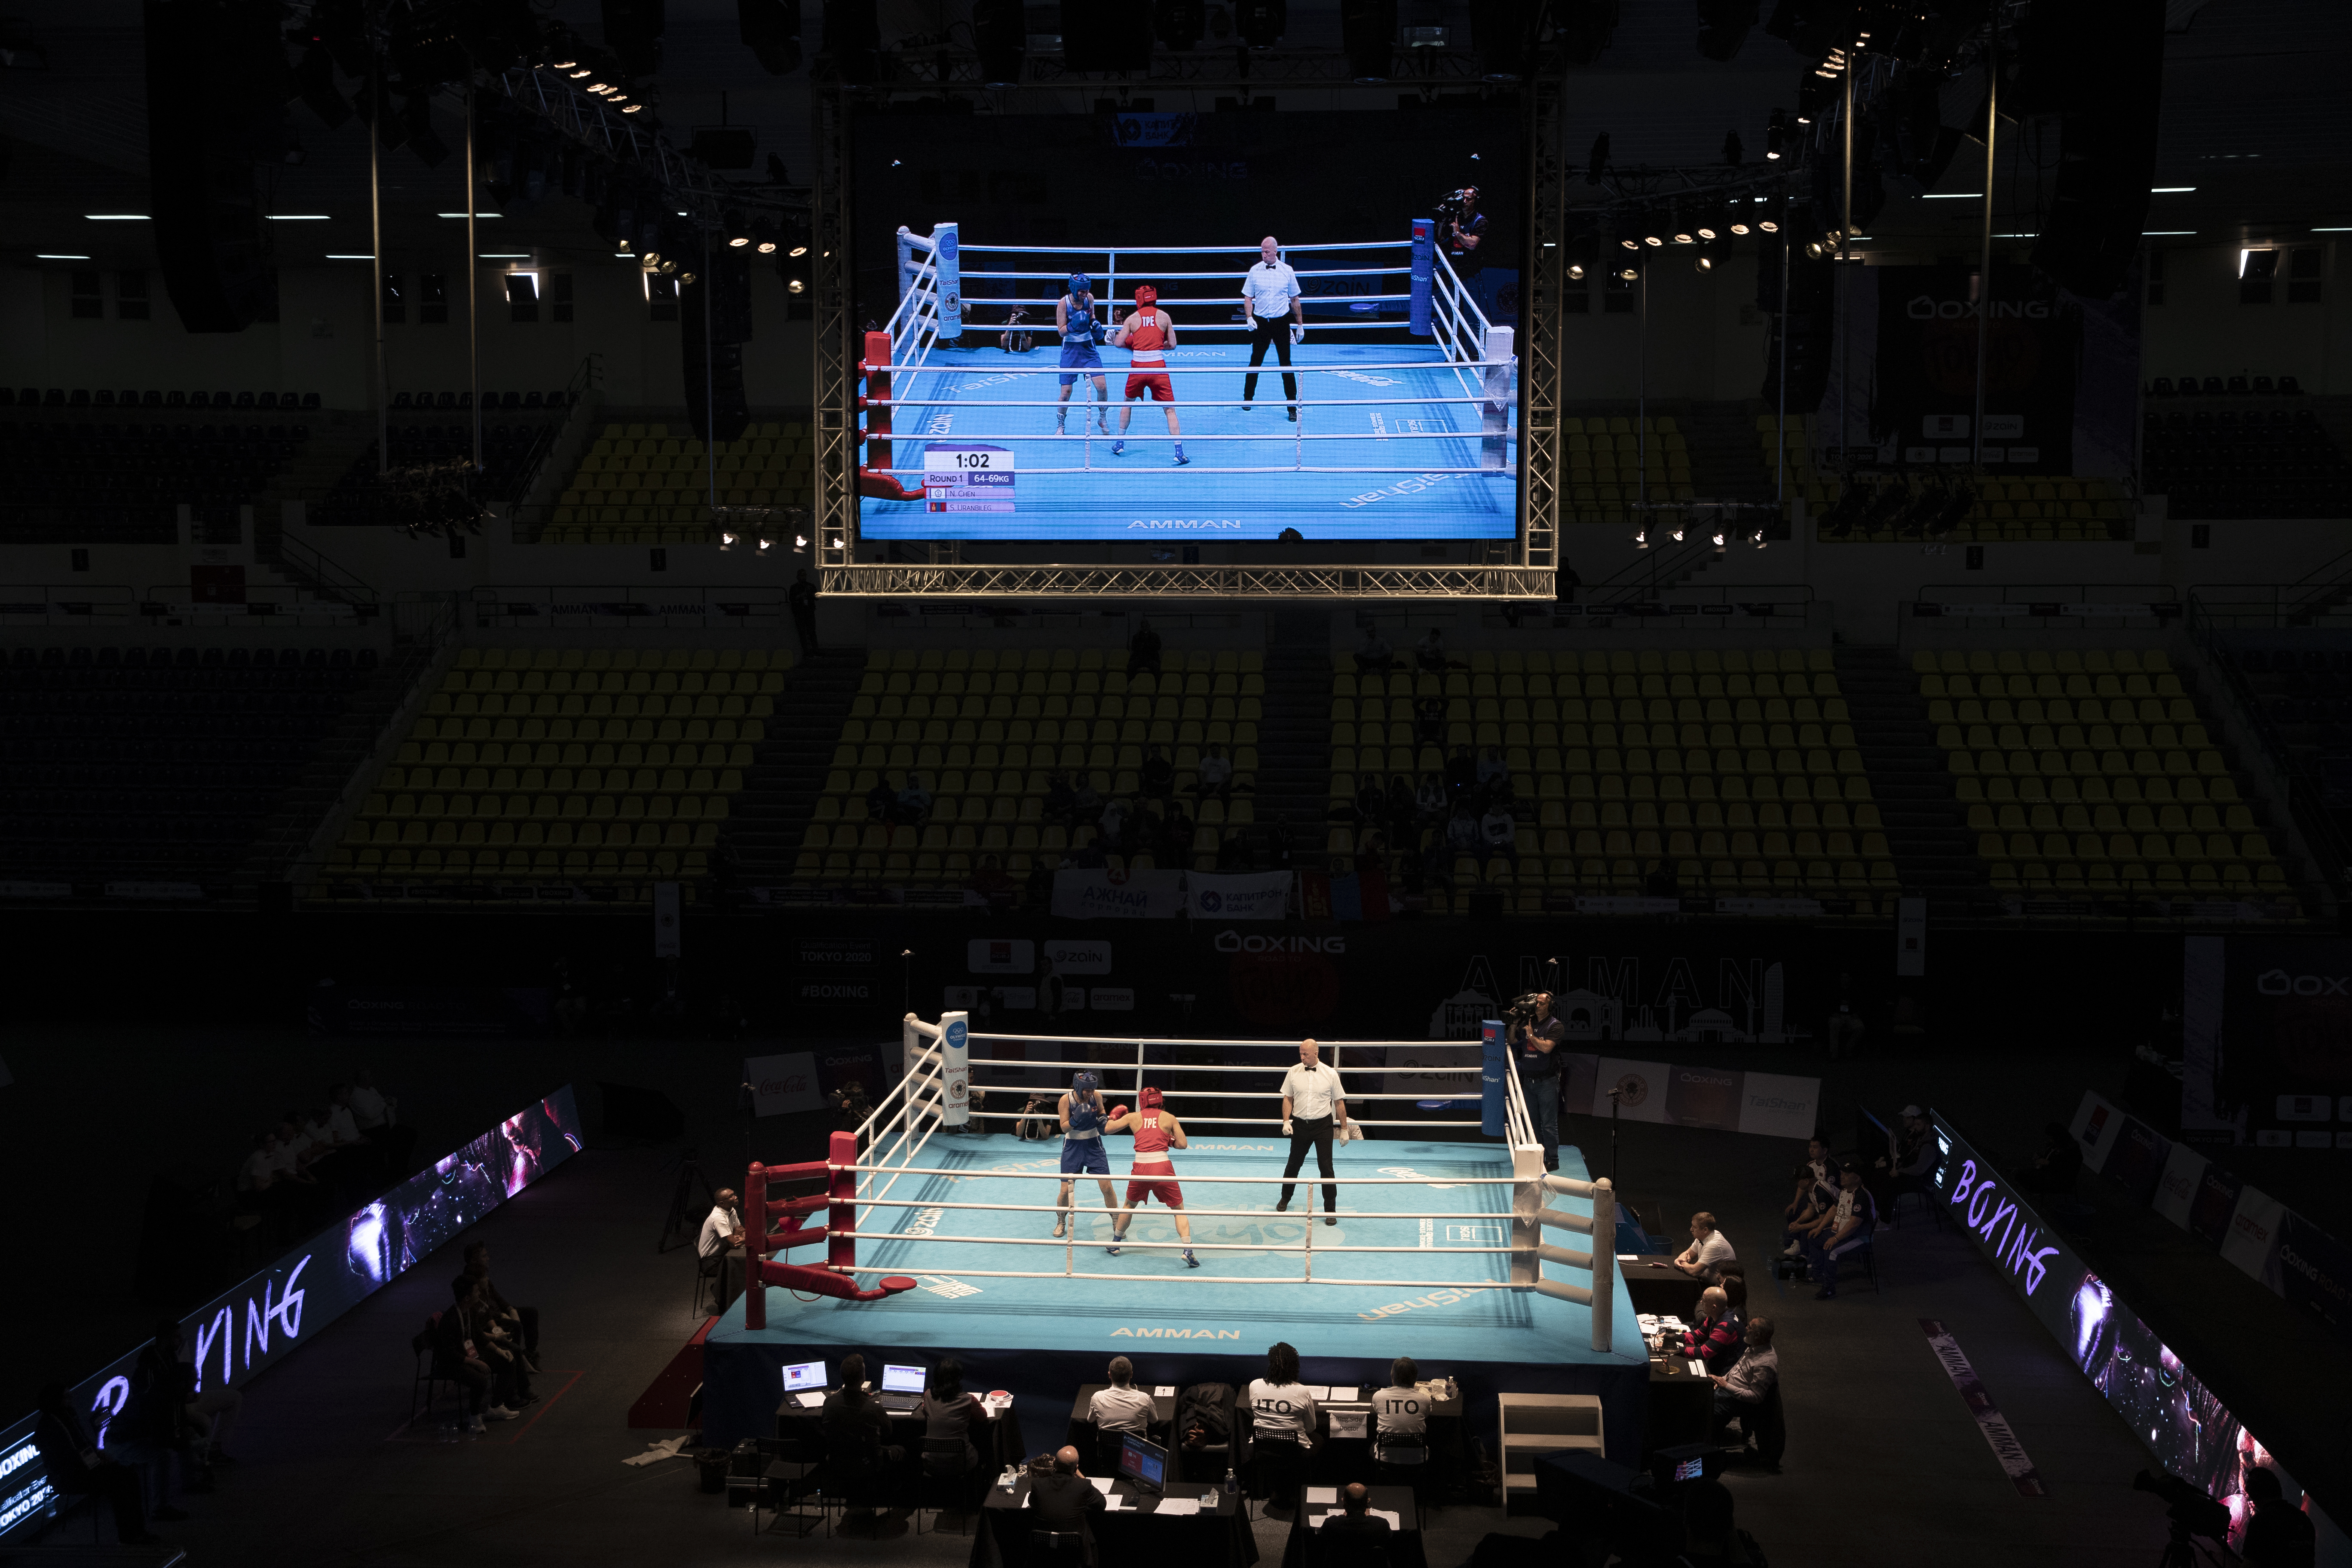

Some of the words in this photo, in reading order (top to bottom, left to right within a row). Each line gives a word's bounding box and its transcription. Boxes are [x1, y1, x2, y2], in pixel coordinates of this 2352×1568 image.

[1907, 295, 2049, 320] BOXING
[1142, 315, 1155, 327] TPE
[956, 454, 989, 468] 1:02
[1127, 520, 1241, 529] AMMAN
[551, 604, 597, 615] AMMAN
[658, 604, 705, 615] AMMAN
[1083, 885, 1148, 908] АЖНАЙ
[1226, 888, 1282, 902] КАПИТРОН
[1081, 901, 1146, 918] корпорац
[1226, 904, 1254, 913] БАНК
[800, 940, 848, 950] Qualification
[849, 941, 872, 949] Event
[1214, 930, 1345, 954] BOXING
[800, 951, 842, 962] TOKYO
[845, 952, 872, 962] 2020
[1068, 949, 1102, 963] zain
[1458, 955, 1763, 1008] AMMAN
[801, 985, 869, 998] #BOXING
[1093, 994, 1131, 1002] aramex
[1681, 1073, 1733, 1087] BOXING
[1750, 1095, 1807, 1111] TaiShan
[1143, 1118, 1157, 1129] TPE
[1951, 1159, 2060, 1296] BOXING
[2236, 1213, 2269, 1244] aramex
[1109, 1327, 1240, 1340] AMMAN
[1936, 1345, 1974, 1378] AMMAN
[1257, 1399, 1291, 1415] ITO
[1386, 1400, 1419, 1415] ITO
[1982, 1421, 2025, 1460] AMMAN
